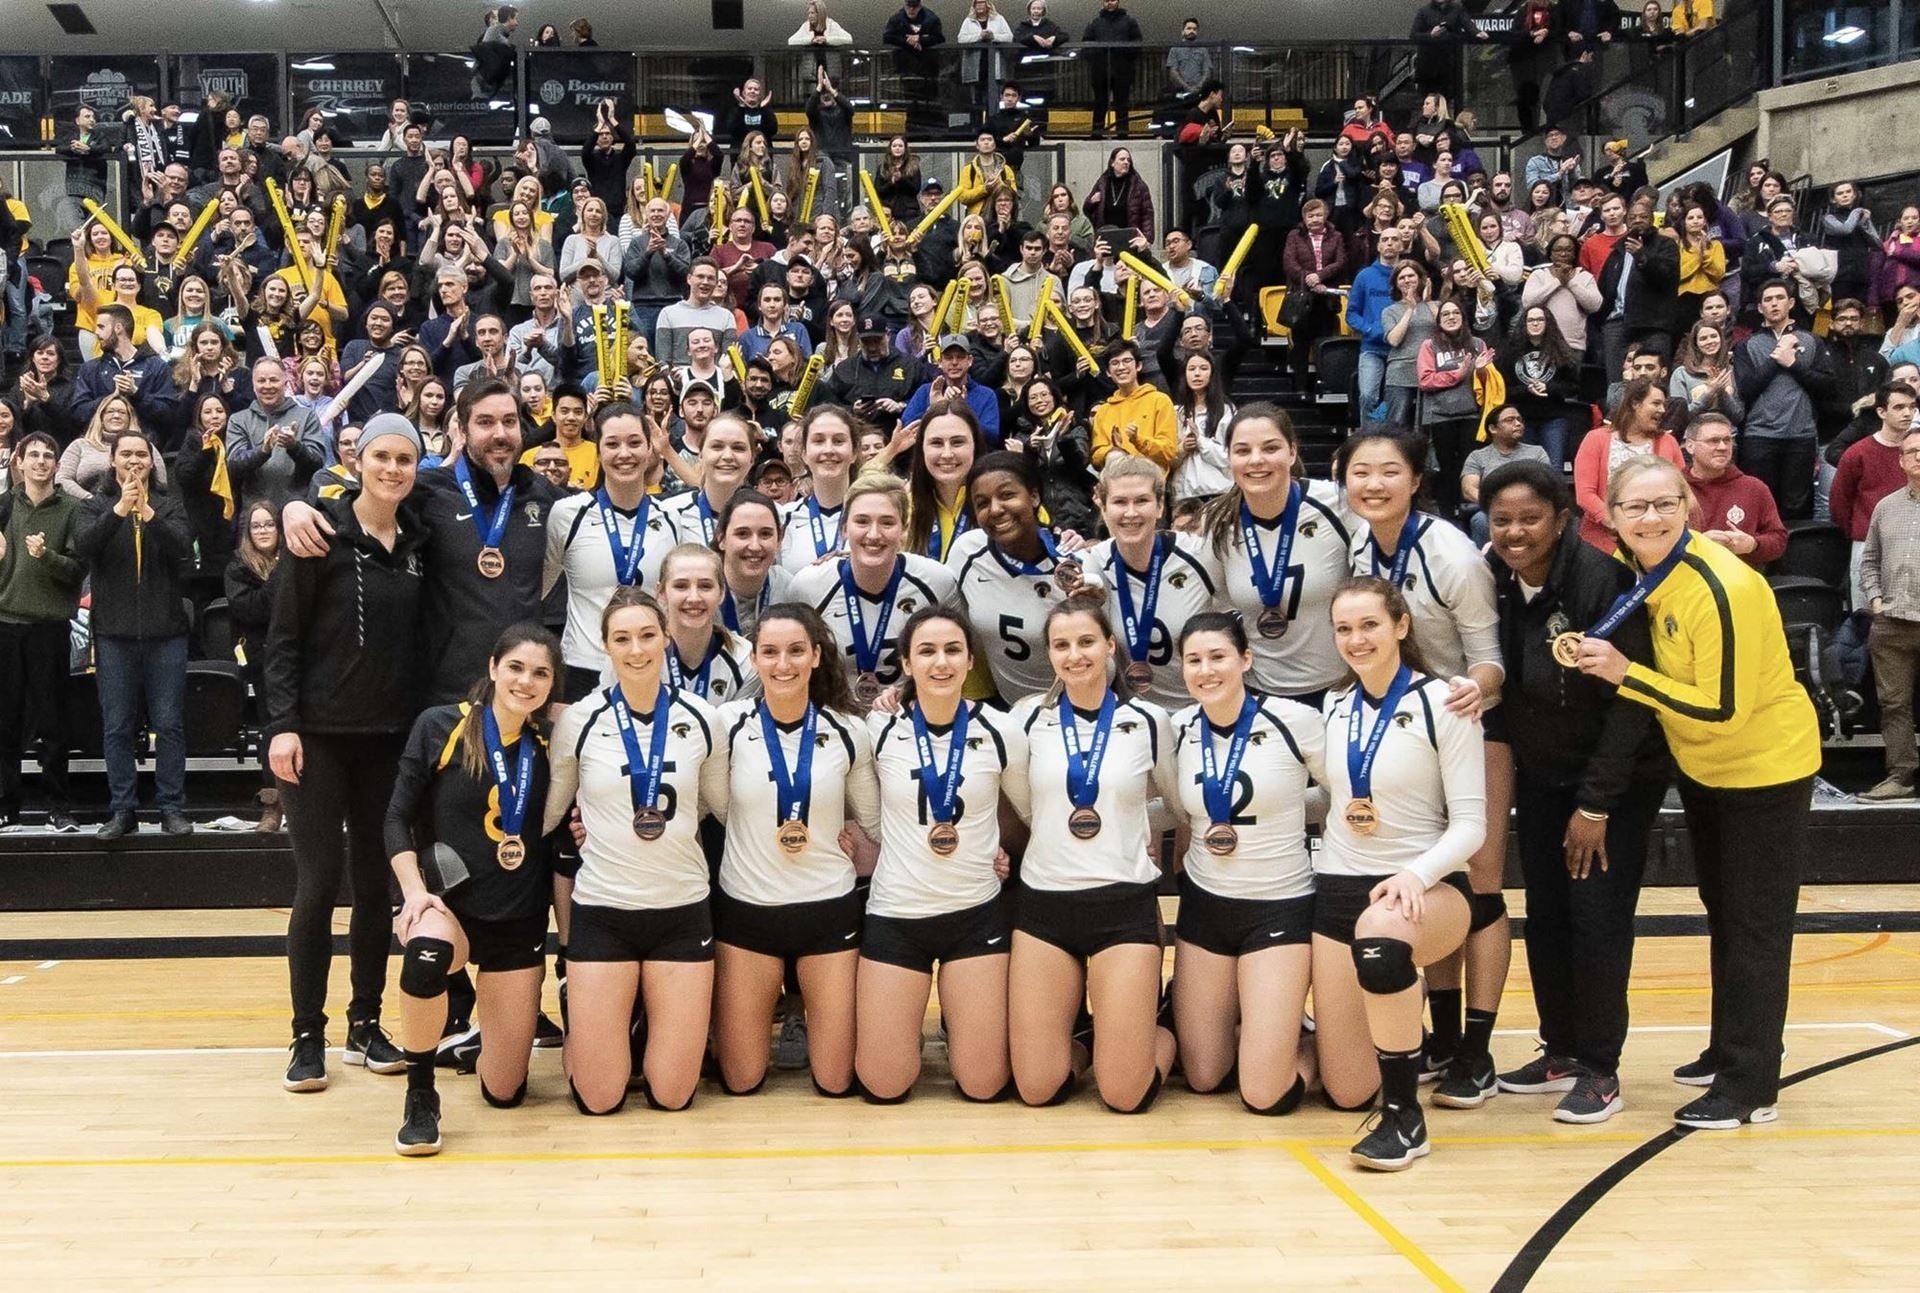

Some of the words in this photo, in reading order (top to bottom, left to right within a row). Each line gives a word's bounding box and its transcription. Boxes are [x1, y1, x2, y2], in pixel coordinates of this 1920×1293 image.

[202, 77, 245, 96] YOUTH
[308, 80, 384, 92] CHERREY
[568, 79, 626, 91] Boston
[575, 94, 618, 105] Piz
[463, 481, 478, 507] OUA
[604, 508, 616, 534] OUA
[812, 517, 823, 542] OUA
[1246, 527, 1258, 558] OUA
[849, 596, 860, 625] OUA
[999, 614, 1031, 662] 5
[1126, 616, 1138, 647] OUA
[1149, 617, 1173, 666] 9
[670, 657, 681, 687] OUA
[616, 701, 631, 731] OUA
[1350, 710, 1360, 743] OUA
[919, 736, 932, 768] OUA
[1065, 726, 1078, 756] OUA
[494, 751, 508, 783] OUA
[1204, 747, 1215, 778] OUA
[1360, 741, 1375, 778] VOLLEYBALL
[944, 769, 957, 806] VOLLEYBALL
[1223, 758, 1237, 795] VOLLEYBALL
[514, 779, 527, 816] VOLLEYBALL
[647, 777, 657, 807] VOLLEYBA
[790, 801, 801, 821] UA
